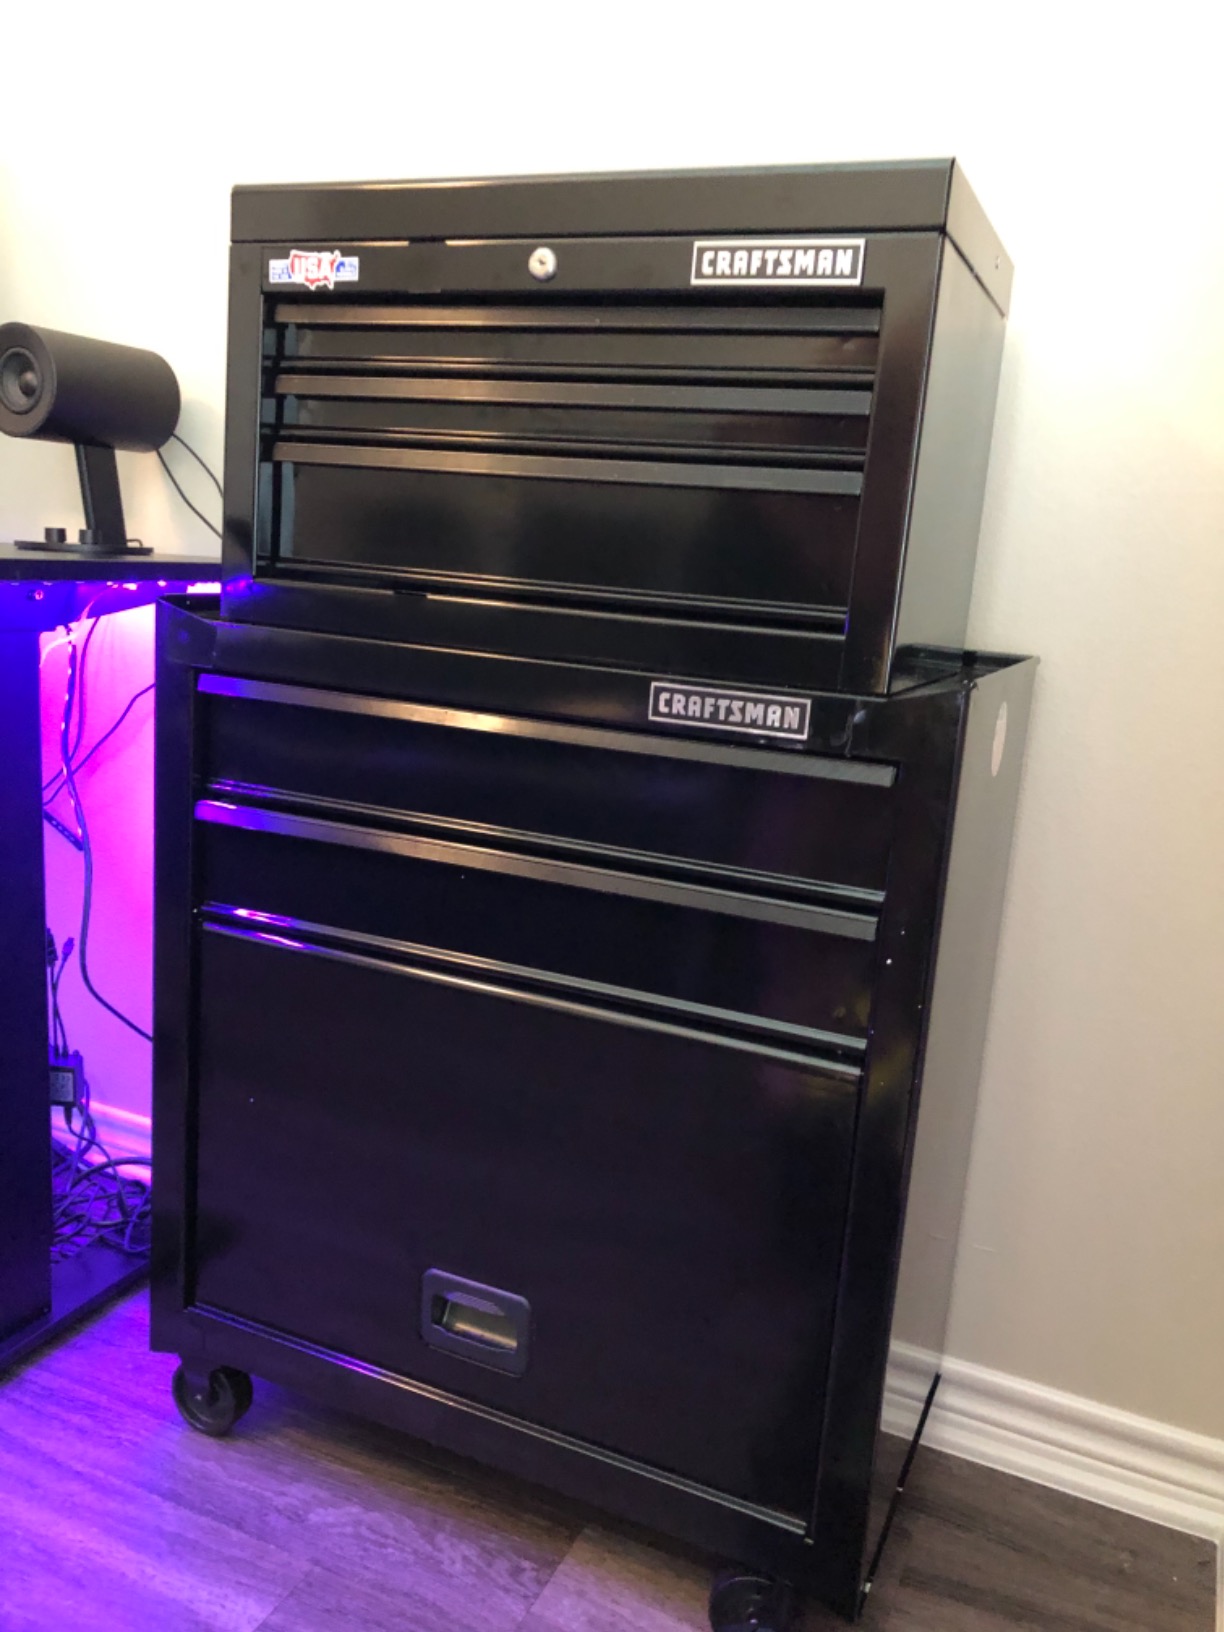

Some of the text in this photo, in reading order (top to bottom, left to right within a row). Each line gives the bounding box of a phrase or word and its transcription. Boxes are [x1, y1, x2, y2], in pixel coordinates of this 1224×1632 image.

[294, 256, 332, 280] USA
[702, 249, 853, 276] CRAFTSMAN
[658, 692, 800, 729] CRAFTSMAN
